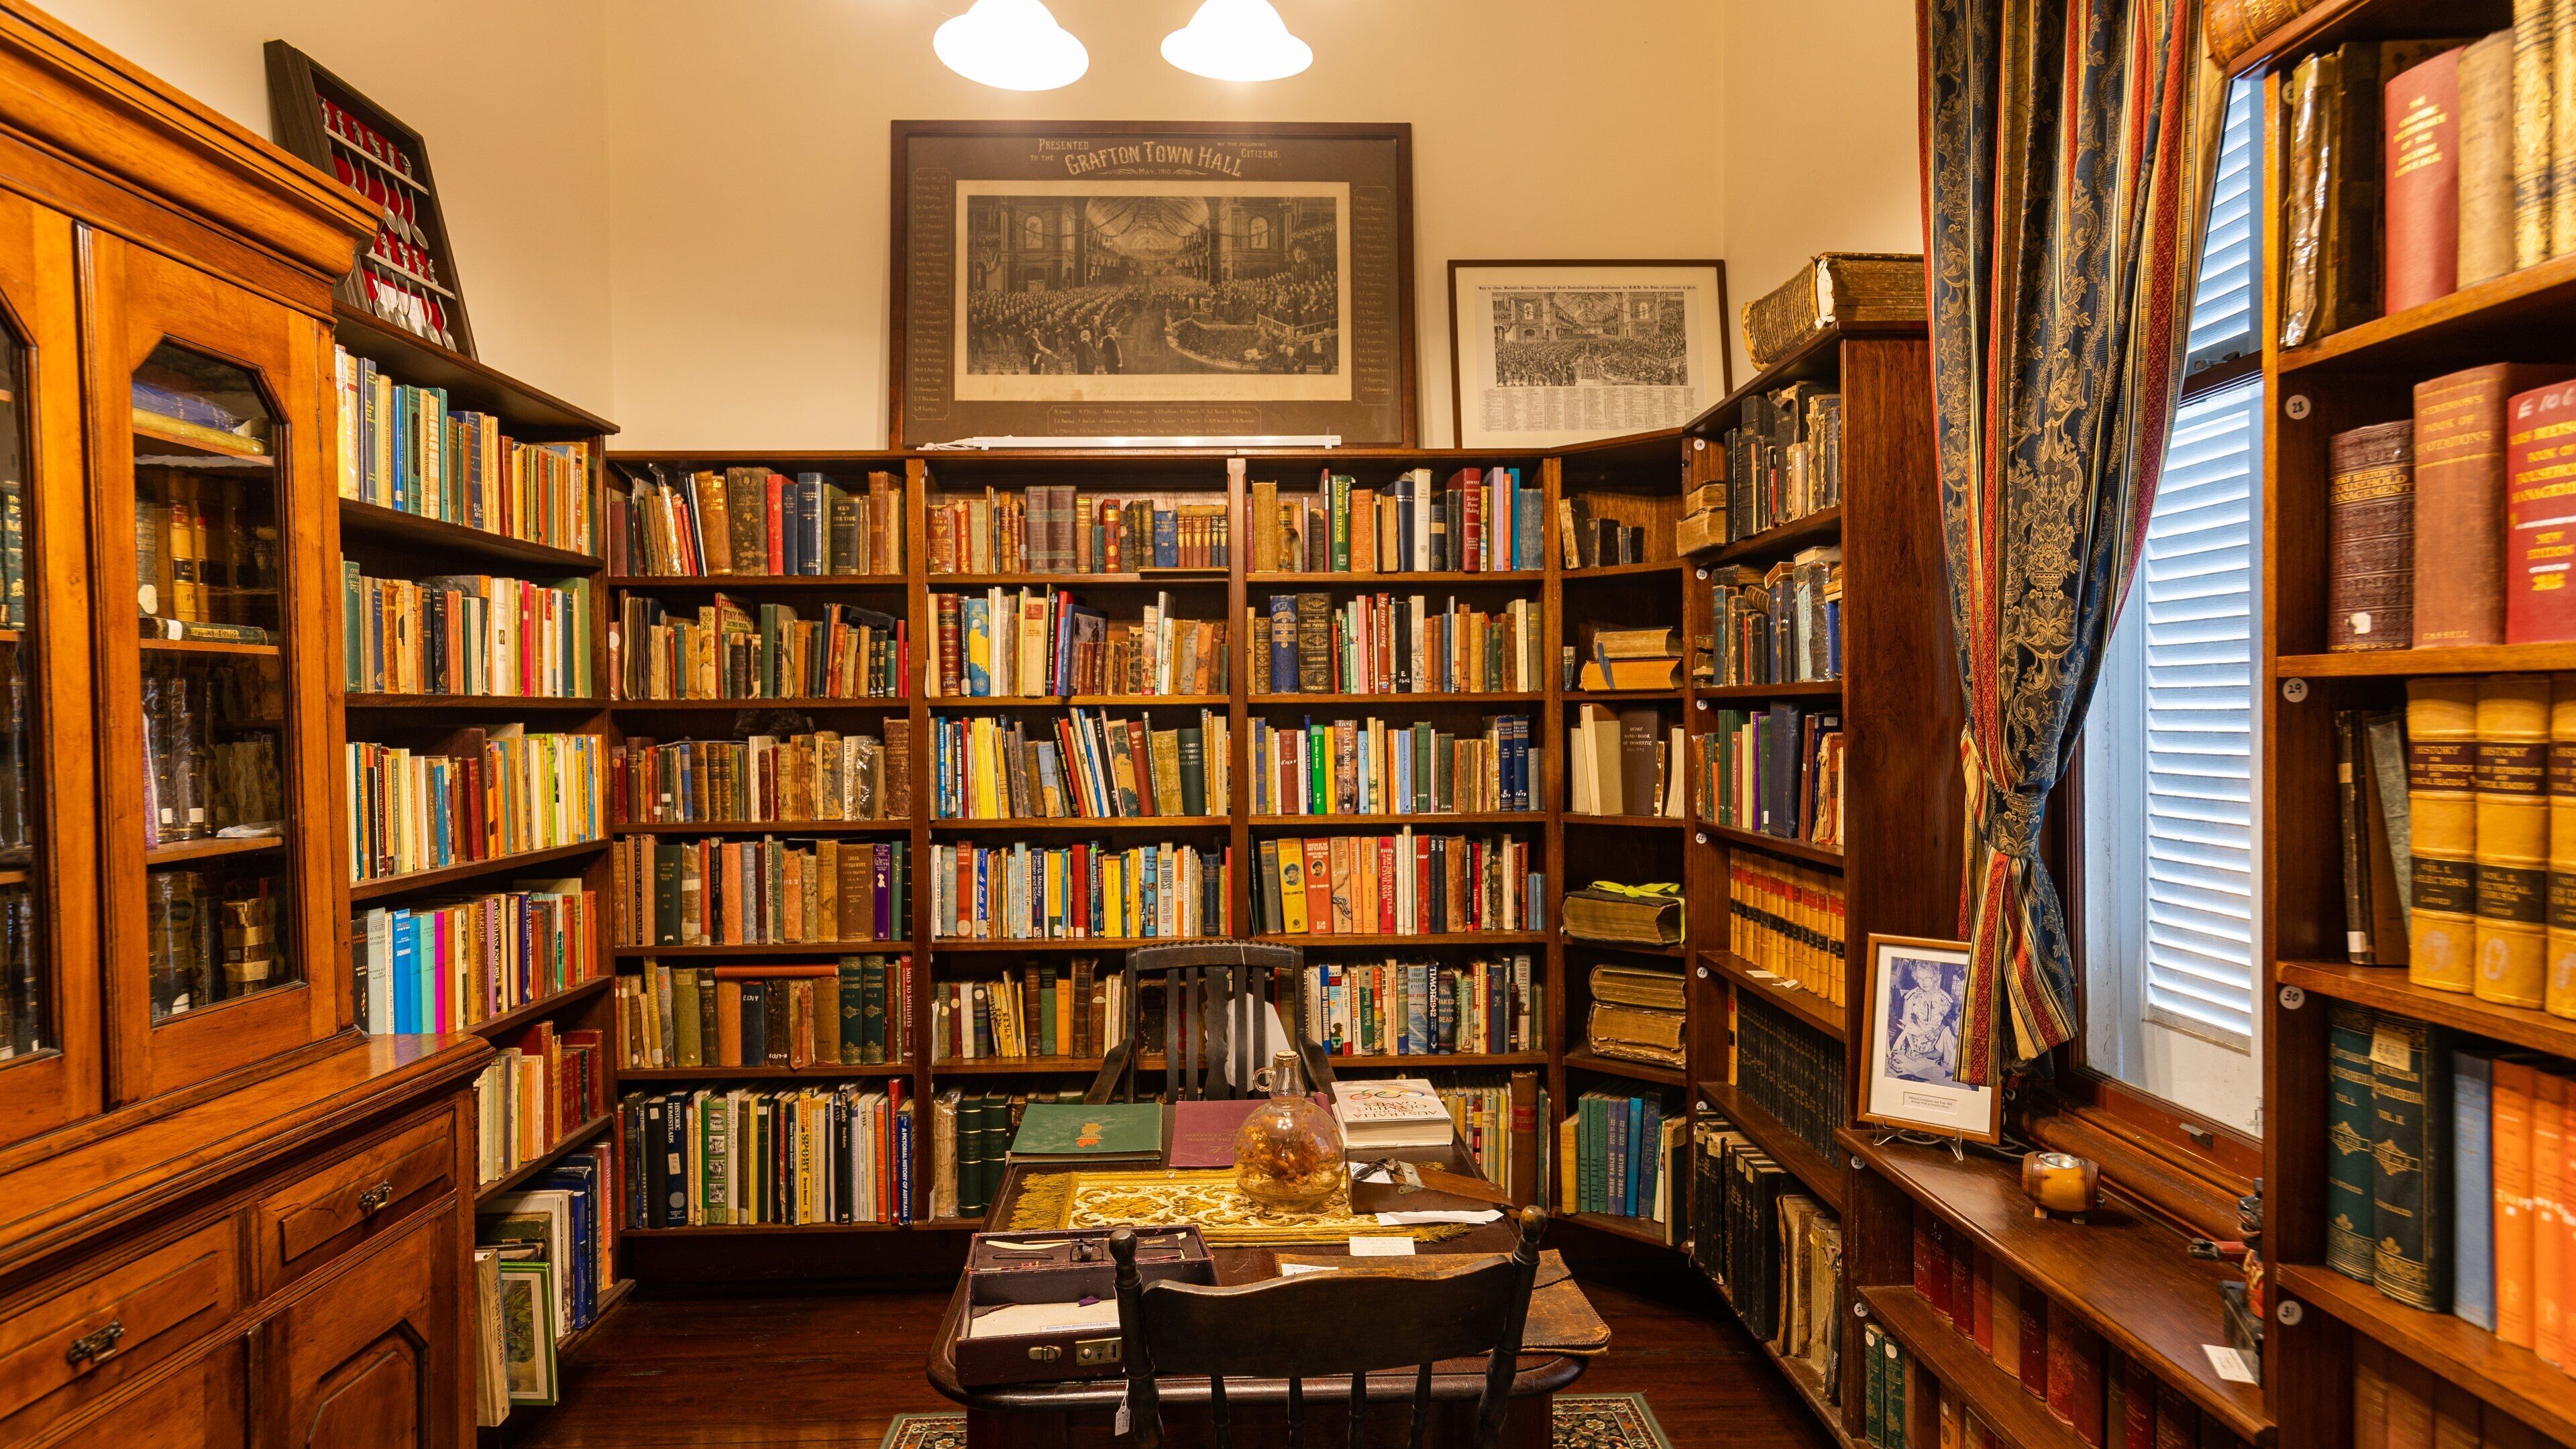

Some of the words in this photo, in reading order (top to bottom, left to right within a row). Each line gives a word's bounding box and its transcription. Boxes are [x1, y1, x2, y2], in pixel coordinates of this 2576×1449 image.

[1038, 138, 1089, 152] PRESENTED
[1065, 145, 1140, 175] GRAFTON
[1143, 141, 1193, 164] TOWN
[1197, 145, 1242, 177] HALL
[2423, 418, 2455, 433] BOOK
[2458, 414, 2476, 426] OF
[1379, 597, 1387, 607] big
[722, 608, 736, 622] TINY
[2288, 683, 2302, 694] 29
[1344, 724, 1352, 744] TOM
[2415, 745, 2462, 755] HISTORY
[2480, 747, 2530, 757] HISTORY
[1343, 745, 1352, 779] ROBERTS
[1161, 859, 1172, 871] ION
[635, 883, 641, 892] OF
[1161, 872, 1172, 890] IDRIESS
[1519, 959, 1527, 998] FROMELLES
[2284, 990, 2300, 1003] 30
[1352, 1110, 1437, 1118] AUSTRALIA
[800, 1134, 810, 1174] SPORT
[494, 1297, 502, 1322] LOST
[496, 1322, 504, 1366] DIGGERS
